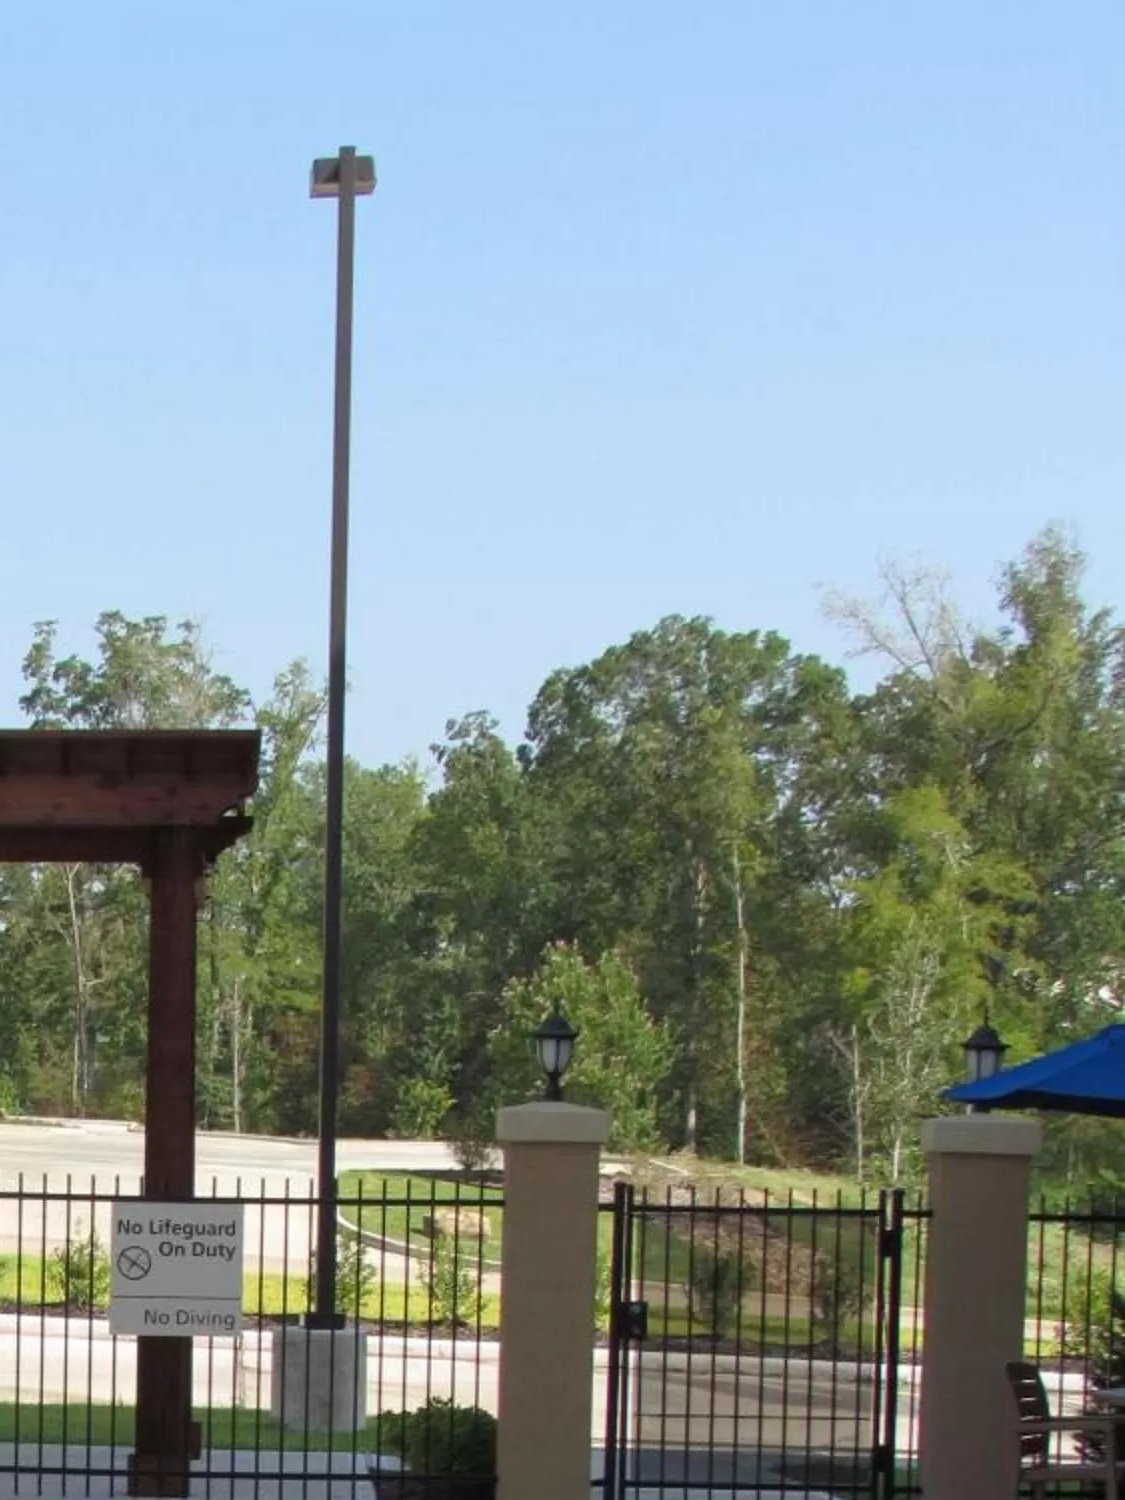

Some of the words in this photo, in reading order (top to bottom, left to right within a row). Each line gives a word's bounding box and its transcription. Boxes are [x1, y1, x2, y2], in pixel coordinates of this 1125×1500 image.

[118, 1219, 143, 1235] No
[149, 1219, 236, 1240] Lifeguard
[158, 1241, 185, 1257] On
[192, 1241, 235, 1262] Duty
[144, 1309, 170, 1325] No
[176, 1309, 235, 1330] Diving
